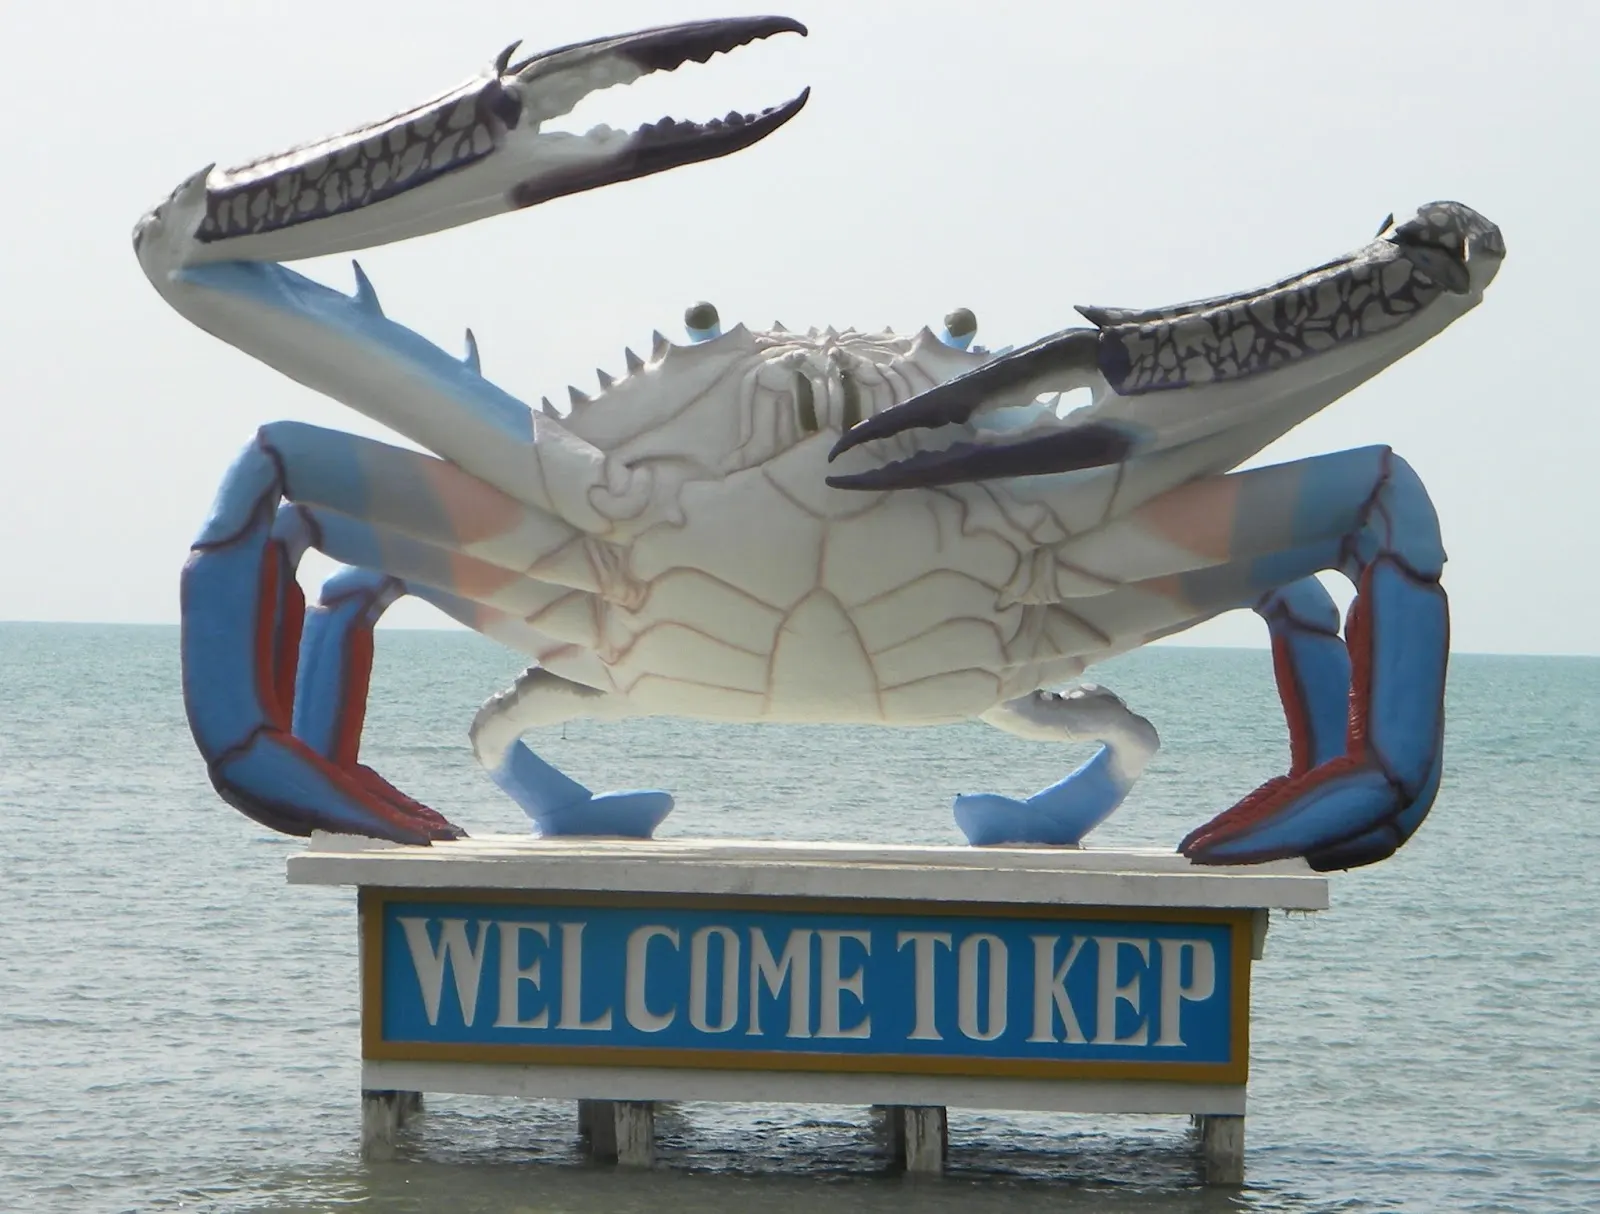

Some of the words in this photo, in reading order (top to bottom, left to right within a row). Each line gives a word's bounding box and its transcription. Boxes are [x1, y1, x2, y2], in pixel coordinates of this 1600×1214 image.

[396, 917, 872, 1039] WELCOME
[896, 931, 1008, 1042] TO
[1025, 935, 1216, 1048] KEP
